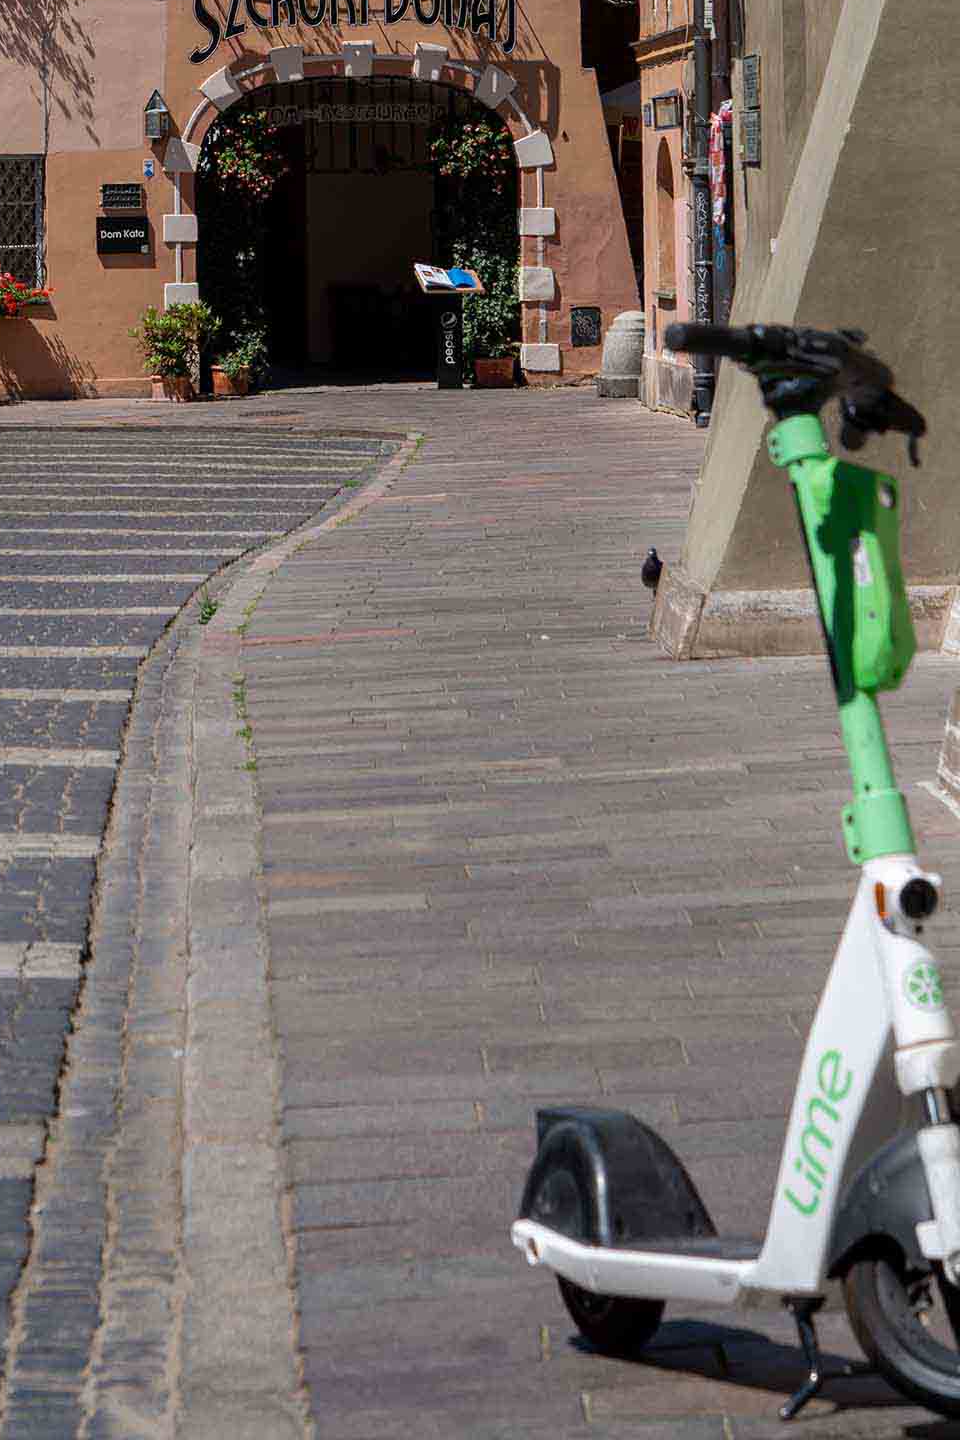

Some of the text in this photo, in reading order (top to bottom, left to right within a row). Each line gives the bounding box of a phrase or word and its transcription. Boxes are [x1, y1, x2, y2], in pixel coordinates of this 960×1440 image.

[100, 229, 145, 239] Dom Kata
[444, 330, 456, 364] pepsi
